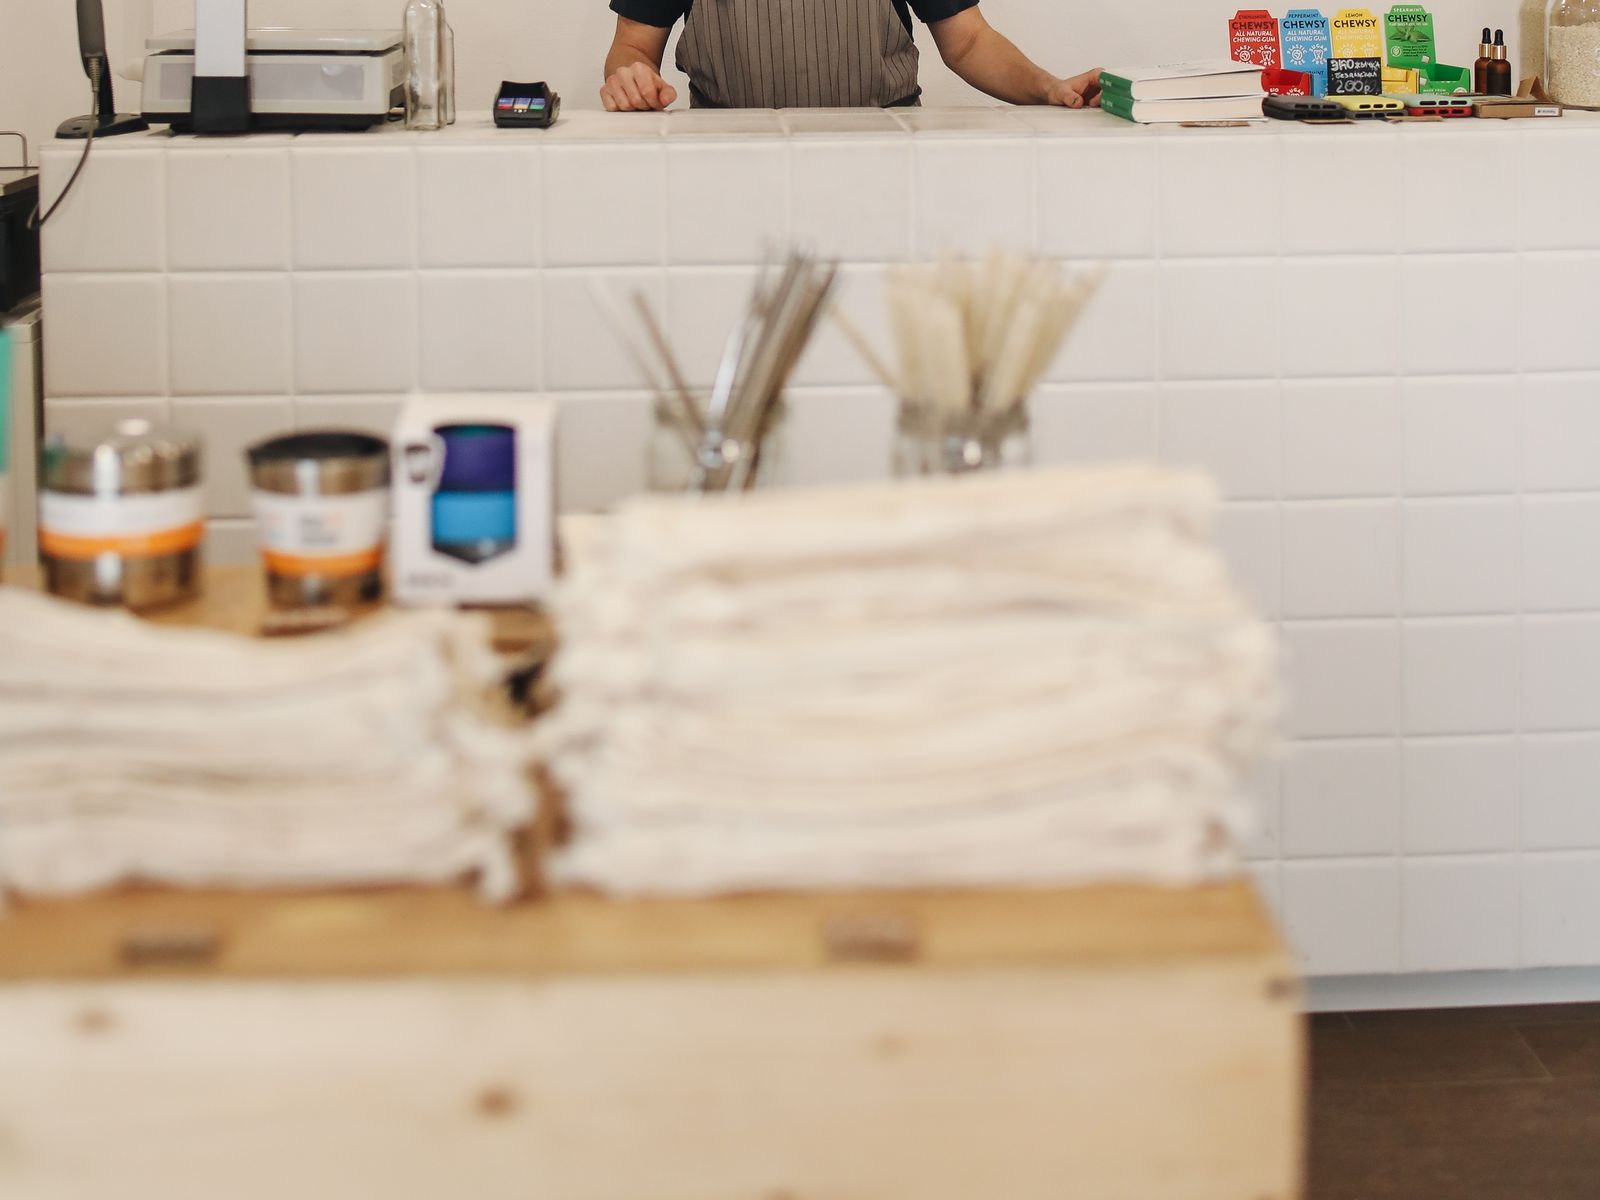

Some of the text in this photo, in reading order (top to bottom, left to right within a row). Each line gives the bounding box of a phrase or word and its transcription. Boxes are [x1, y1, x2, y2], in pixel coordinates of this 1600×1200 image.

[1388, 14, 1428, 22] CHEWSY
[1232, 21, 1275, 30] CHEWSY
[1283, 20, 1326, 29] CHEWSY
[1334, 19, 1377, 28] CHEWSY
[1234, 45, 1256, 55] PLASTIC
[1257, 44, 1276, 53] SUGAR
[1286, 44, 1308, 54] PLASTIC
[1309, 43, 1328, 52] SUGAR
[1286, 87, 1304, 96] SUGAR
